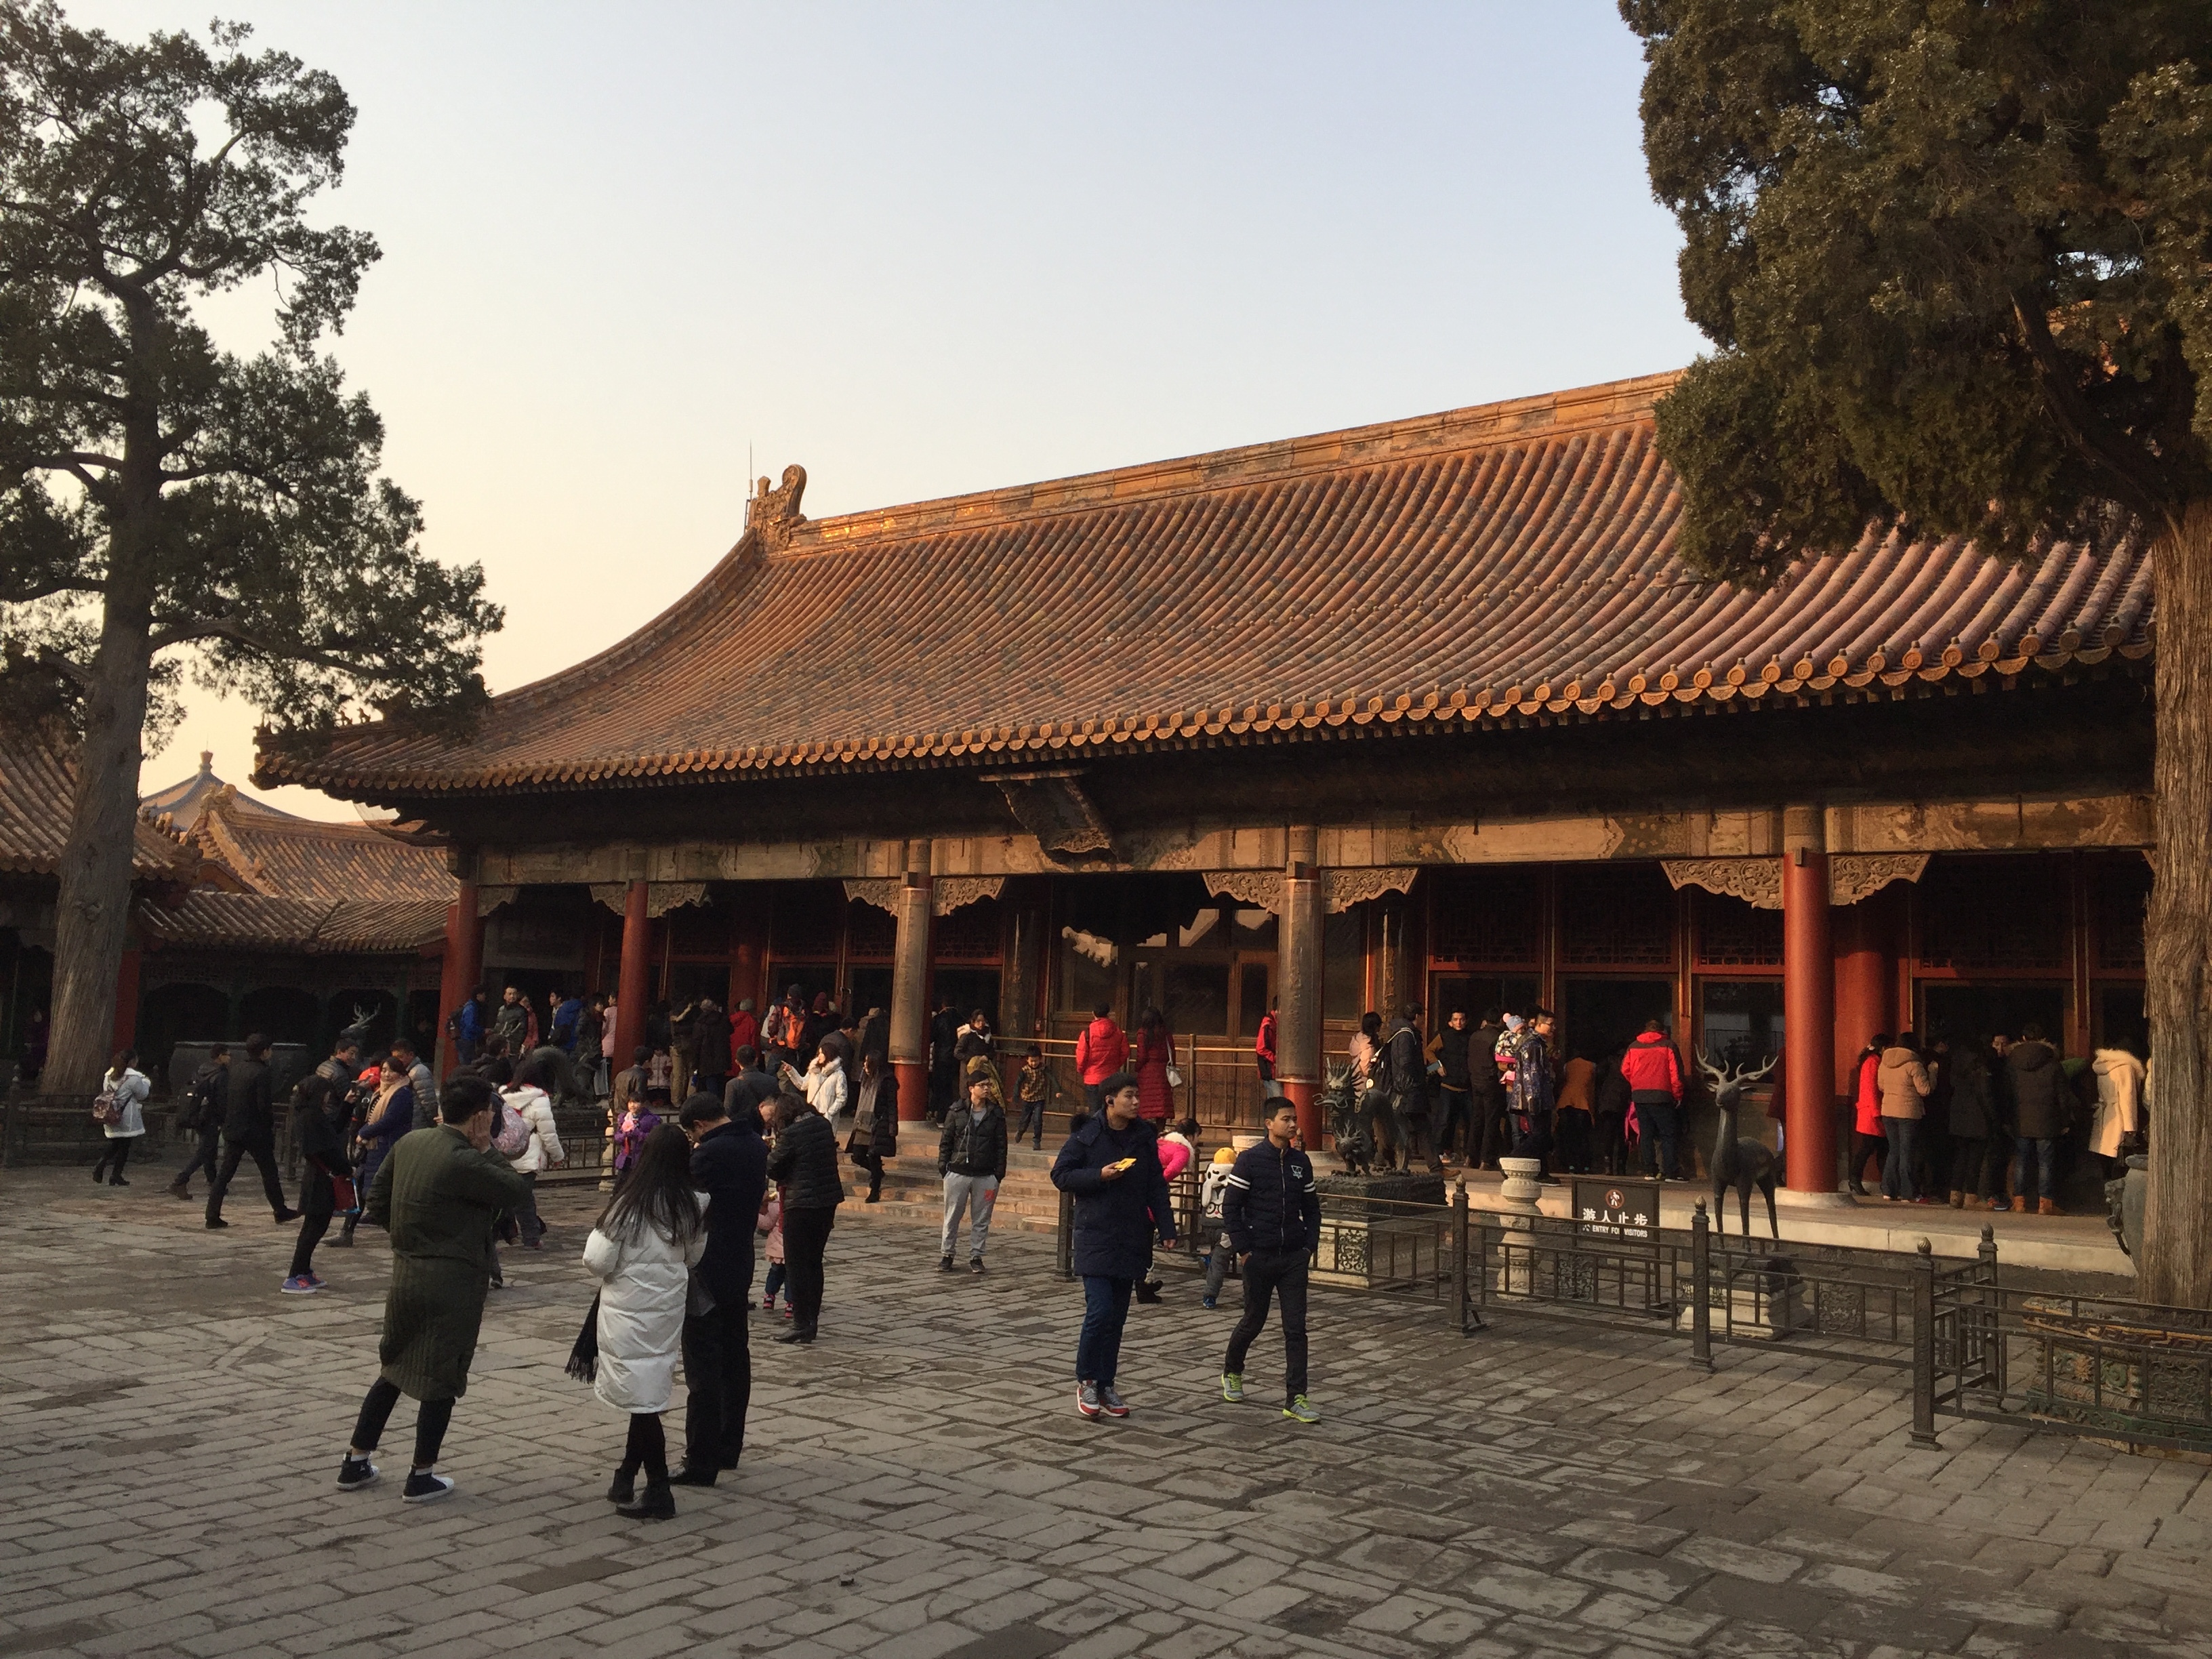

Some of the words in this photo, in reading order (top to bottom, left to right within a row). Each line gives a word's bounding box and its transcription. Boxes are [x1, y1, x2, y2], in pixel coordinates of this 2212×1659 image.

[1582, 1208, 1648, 1226] 游人止步
[1593, 1225, 1609, 1233] ENTRY
[1624, 1228, 1647, 1237] VISITORS
